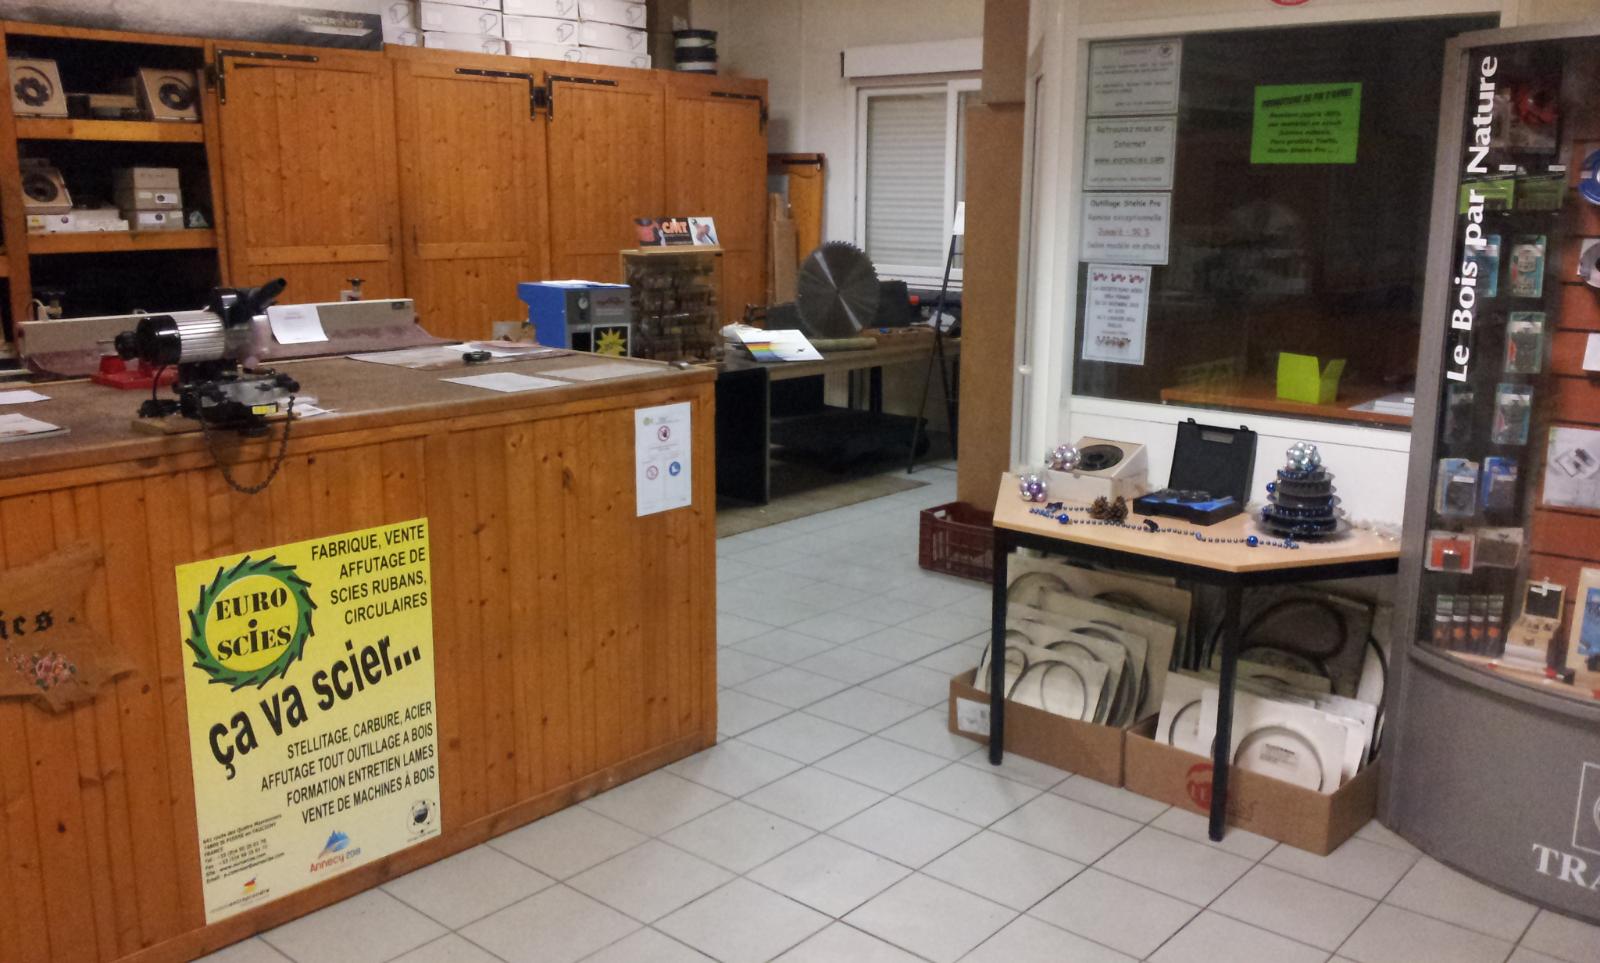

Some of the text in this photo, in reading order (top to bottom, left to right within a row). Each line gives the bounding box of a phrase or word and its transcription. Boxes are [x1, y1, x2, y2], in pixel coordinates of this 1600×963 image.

[1446, 55, 1498, 382] Le Bois par Nature
[311, 524, 425, 561] FABRIQUE, VENTE
[340, 547, 425, 579] AFFUTAGE DE
[215, 587, 288, 621] EURO
[330, 570, 427, 605] SCIES RUBANS,
[344, 592, 428, 625] CIRCULAIRES
[209, 635, 421, 781] ça va scier...
[287, 701, 433, 759] STELLITAGE, CARBURE, ACIER
[261, 760, 316, 792] AFFUTAGE
[318, 751, 345, 773] TOUT
[347, 733, 401, 763] OUTILLAGE
[411, 722, 433, 742] BOIS
[286, 744, 434, 807] FORMATION ENTRETIEN LAMES
[302, 801, 335, 824] VENTE
[337, 795, 351, 812] DE
[353, 777, 403, 805] MACHINES
[413, 765, 435, 784] BOIS
[310, 853, 345, 873] Annecy
